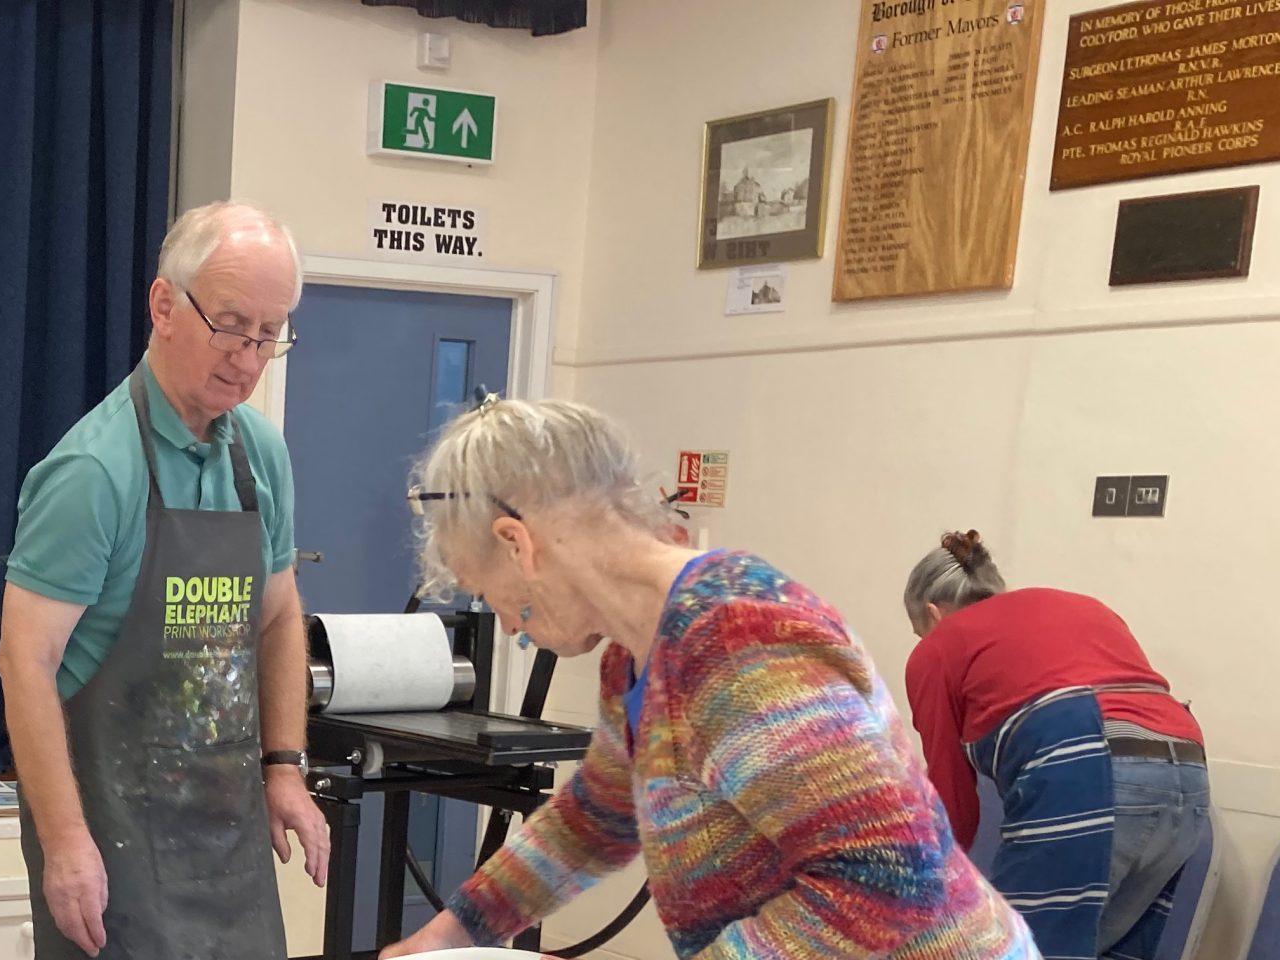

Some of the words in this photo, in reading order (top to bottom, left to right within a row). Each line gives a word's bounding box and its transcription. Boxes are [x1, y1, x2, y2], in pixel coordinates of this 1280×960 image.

[892, 27, 942, 48] Former
[947, 14, 999, 38] Mayors
[1080, 19, 1093, 32] IN
[1095, 10, 1142, 29] MEMORY
[1146, 6, 1162, 19] OF
[1142, 21, 1170, 35] WHO
[1173, 14, 1205, 30] GAVE
[1209, 6, 1242, 23] THEIR
[1246, 0, 1280, 16] LIVES
[1069, 61, 1119, 80] SURGEON
[1135, 49, 1182, 68] THOMAS
[1186, 41, 1228, 58] JAMES
[1067, 89, 1113, 108] LEADING
[1116, 82, 1166, 99] SEAMAN
[1167, 73, 1214, 90] ARTHUR
[1217, 63, 1280, 82] LAWRENCE
[1089, 116, 1126, 133] RALPH
[1128, 109, 1175, 127] HAROLD
[1177, 100, 1228, 118] ANNING
[1062, 146, 1086, 160] PTE.
[1090, 137, 1138, 156] THOMAS
[1140, 129, 1200, 148] REGINALD
[1202, 119, 1264, 138] HAWKINS
[1120, 149, 1157, 165] ROYAL
[1163, 142, 1213, 159] PIONEER
[1218, 135, 1259, 151] CORPS
[382, 203, 475, 229] TOILETS
[373, 228, 425, 252] THIS
[435, 233, 483, 257] WAY.
[165, 576, 253, 603] DOUBLE
[165, 603, 250, 624] ELEPHANT
[163, 625, 197, 640] PRINT
